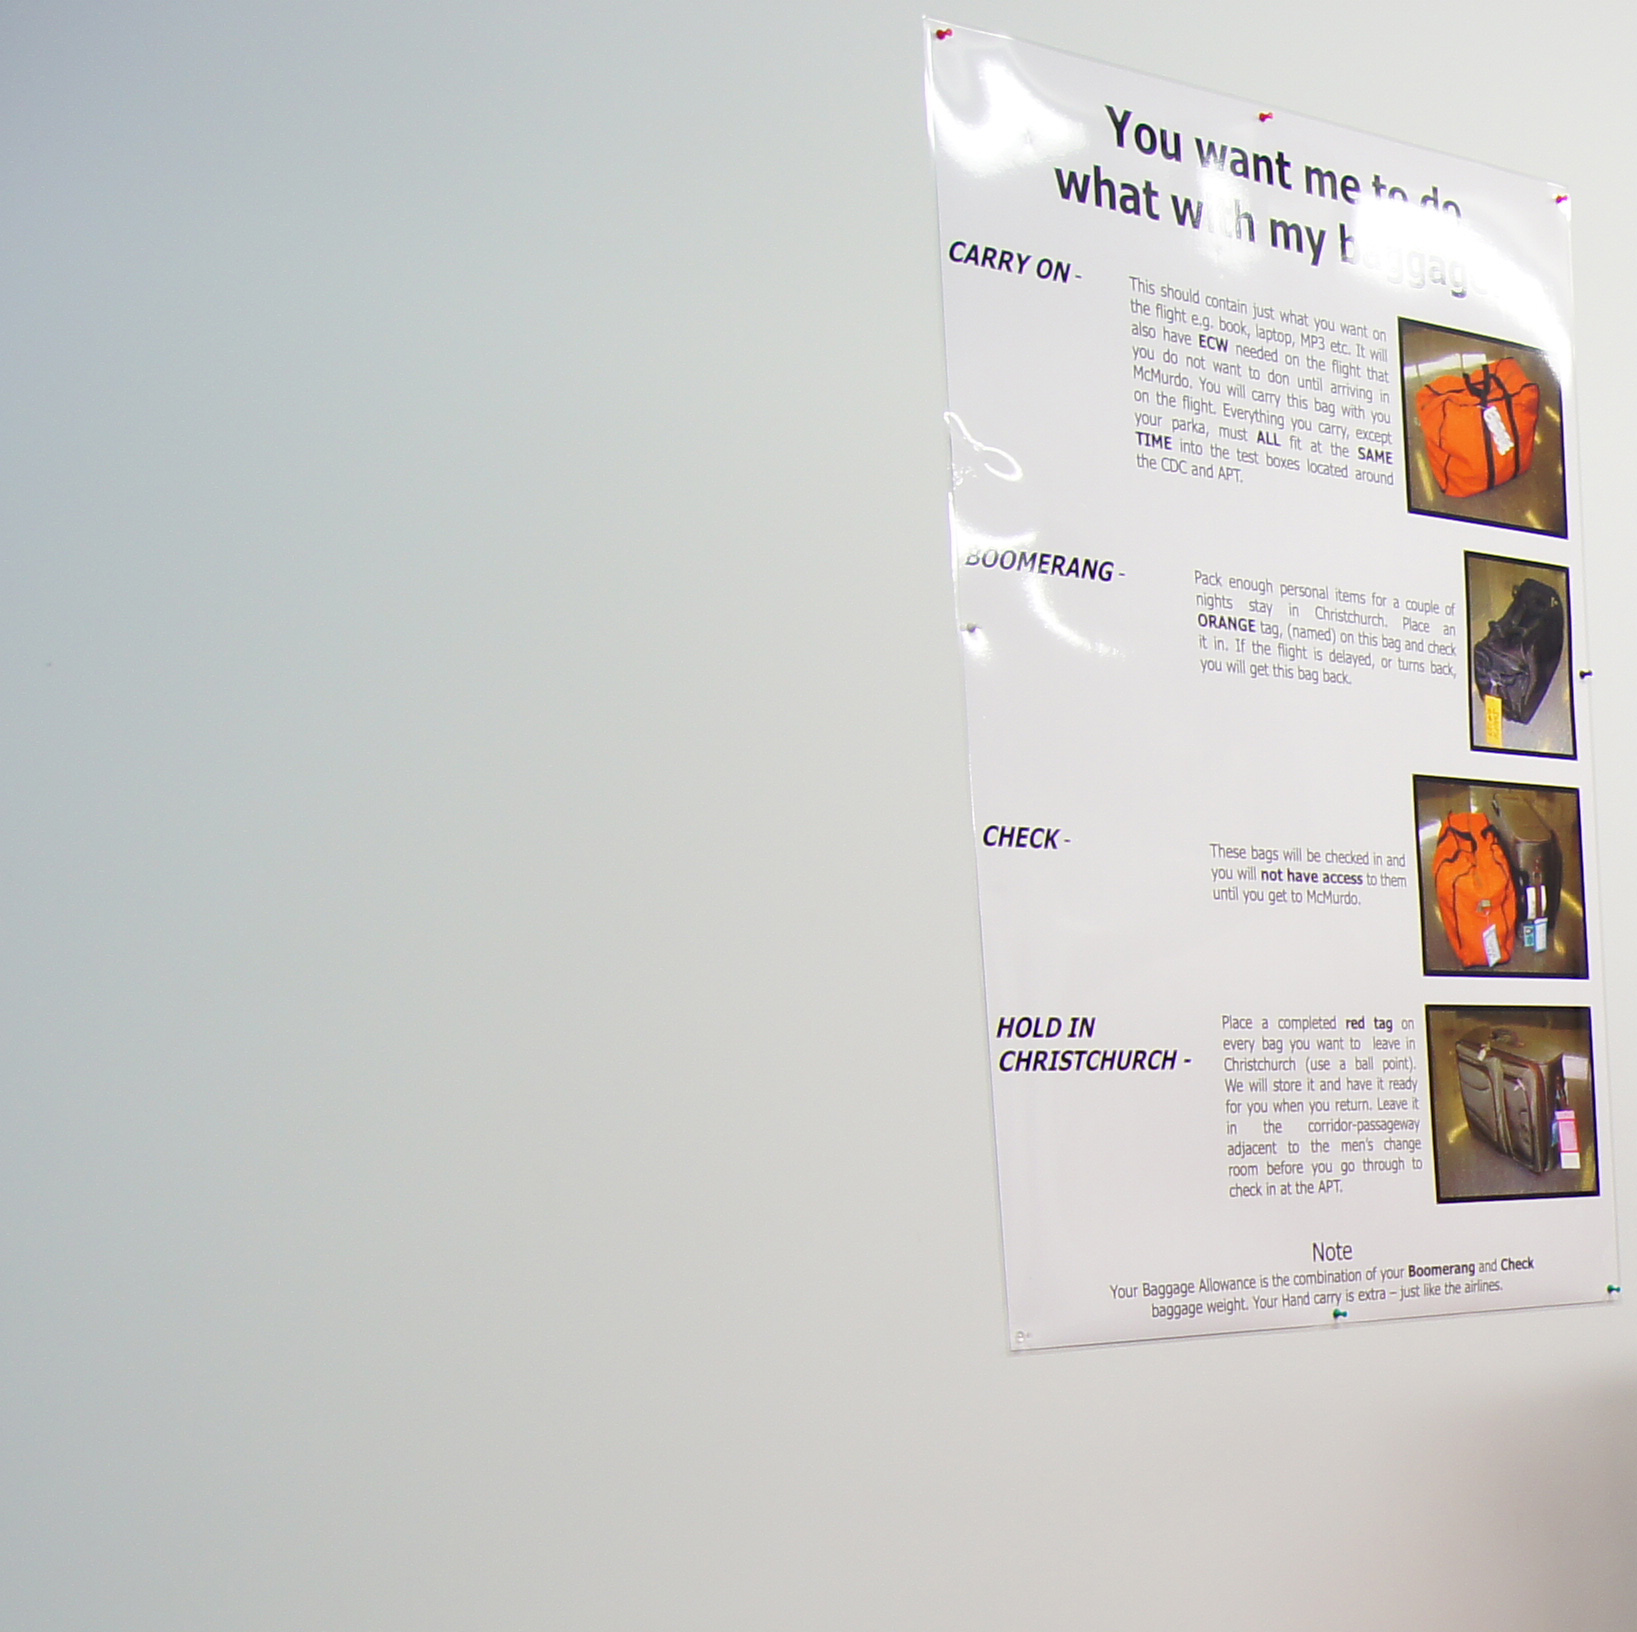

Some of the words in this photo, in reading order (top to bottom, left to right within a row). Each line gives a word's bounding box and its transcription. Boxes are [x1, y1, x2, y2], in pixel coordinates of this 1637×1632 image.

[1104, 104, 1182, 163] You
[1194, 136, 1293, 191] want
[1304, 165, 1361, 205] me
[1053, 164, 1160, 221] what
[1269, 218, 1327, 267] my
[948, 240, 1031, 275] CARRY
[1035, 257, 1072, 284] ON
[1128, 275, 1156, 295] This
[1160, 283, 1200, 305] should
[1205, 295, 1248, 314] contain
[1252, 305, 1275, 321] just
[1279, 310, 1309, 327] what
[1314, 318, 1335, 332] you
[1340, 323, 1367, 338] want
[1372, 329, 1386, 341] on
[1130, 298, 1151, 316] the
[1155, 302, 1187, 324] flight
[1191, 314, 1214, 332] e.g.
[1219, 316, 1251, 339] book,
[1255, 325, 1295, 347] laptop,
[1300, 332, 1325, 351] MP3
[1330, 340, 1351, 355] etc.
[1356, 343, 1365, 358] It
[1370, 350, 1388, 361] will
[965, 550, 1115, 583] BOOMERANG
[1194, 569, 1222, 587] Pack
[1228, 577, 1273, 596] enough
[1279, 583, 1329, 600] personal
[1335, 589, 1366, 605] items
[1371, 592, 1387, 607] for
[1393, 598, 1400, 609] a
[1405, 600, 1440, 615] couple
[1445, 603, 1455, 616] of
[982, 824, 1061, 850] CHECK
[1209, 843, 1247, 860] These
[1250, 845, 1279, 864] bags
[1282, 848, 1302, 862] will
[1306, 848, 1321, 863] be
[1325, 849, 1370, 866] checked
[1373, 855, 1383, 866] in
[1386, 854, 1406, 868] and
[1211, 868, 1233, 882] you
[1237, 866, 1257, 881] will
[1260, 868, 1284, 882] not
[1286, 867, 1319, 884] have
[1322, 872, 1364, 886] access
[1366, 873, 1378, 886] to
[1380, 872, 1407, 887] them
[1213, 886, 1239, 901] until
[1242, 890, 1264, 905] you
[1268, 889, 1288, 906] get
[1290, 889, 1303, 904] to
[1306, 889, 1361, 905] McMurdo.
[995, 1016, 1063, 1039] HOLD
[1066, 1016, 1097, 1039] IN
[1221, 1015, 1253, 1030] Place
[1261, 1018, 1269, 1030] a
[1277, 1015, 1337, 1033] completed
[1345, 1015, 1366, 1030] red
[1373, 1016, 1393, 1033] tag
[1401, 1019, 1415, 1030] on
[1222, 1039, 1255, 1054] every
[1261, 1036, 1283, 1054] bag
[1289, 1039, 1310, 1054] you
[1316, 1037, 1344, 1050] want
[1349, 1037, 1361, 1050] to
[1372, 1036, 1401, 1050] leave
[1406, 1039, 1416, 1049] in
[998, 1049, 1178, 1073] CHRISTCHURCH
[1223, 1056, 1296, 1072] Christchurch
[1305, 1056, 1331, 1074] (use
[1339, 1059, 1346, 1071] a
[1355, 1056, 1374, 1071] ball
[1382, 1056, 1416, 1073] point).
[1224, 1078, 1244, 1093] We
[1248, 1077, 1268, 1092] will
[1273, 1078, 1302, 1092] store
[1307, 1078, 1315, 1092] it
[1319, 1077, 1342, 1091] and
[1346, 1077, 1373, 1091] have
[1377, 1078, 1384, 1091] it
[1388, 1076, 1418, 1093] ready
[1225, 1099, 1242, 1114] for
[1246, 1102, 1268, 1117] you
[1272, 1098, 1304, 1113] when
[1308, 1101, 1330, 1115] you
[1335, 1098, 1373, 1112] return.
[1377, 1097, 1408, 1111] Leave
[1412, 1097, 1419, 1110] it
[1226, 1121, 1237, 1135] in
[1263, 1119, 1282, 1134] the
[1308, 1118, 1420, 1135] corridor-passageway
[1227, 1141, 1277, 1159] adjacent
[1287, 1141, 1300, 1154] to
[1310, 1138, 1330, 1154] the
[1341, 1137, 1374, 1152] men's
[1383, 1137, 1422, 1154] change
[1228, 1164, 1259, 1177] room
[1266, 1160, 1304, 1176] before
[1311, 1162, 1333, 1177] you
[1340, 1161, 1355, 1176] go
[1362, 1156, 1405, 1174] through
[1411, 1157, 1423, 1170] to
[1229, 1182, 1263, 1198] check
[1266, 1182, 1277, 1196] in
[1280, 1182, 1292, 1196] at
[1295, 1181, 1315, 1195] the
[1318, 1179, 1343, 1193] APT.
[1312, 1241, 1353, 1263] Note
[1109, 1284, 1139, 1299] Your
[1142, 1282, 1195, 1300] Baggage
[1198, 1277, 1257, 1293] Allowance
[1260, 1277, 1269, 1288] is
[1271, 1273, 1290, 1288] the
[1293, 1269, 1362, 1286] combination
[1365, 1266, 1377, 1281] of
[1380, 1268, 1405, 1283] your
[1407, 1263, 1476, 1278] Boomerang
[1478, 1258, 1498, 1273] and
[1500, 1256, 1535, 1272] Check
[1151, 1303, 1203, 1321] baggage
[1206, 1297, 1249, 1316] weight.
[1252, 1295, 1278, 1310] Your
[1281, 1291, 1310, 1307] Hand
[1313, 1292, 1342, 1307] carry
[1345, 1289, 1355, 1303] is
[1357, 1288, 1386, 1302] extra
[1399, 1285, 1421, 1302] just
[1423, 1283, 1441, 1296] like
[1444, 1281, 1462, 1295] the
[1464, 1279, 1503, 1294] airlines.
